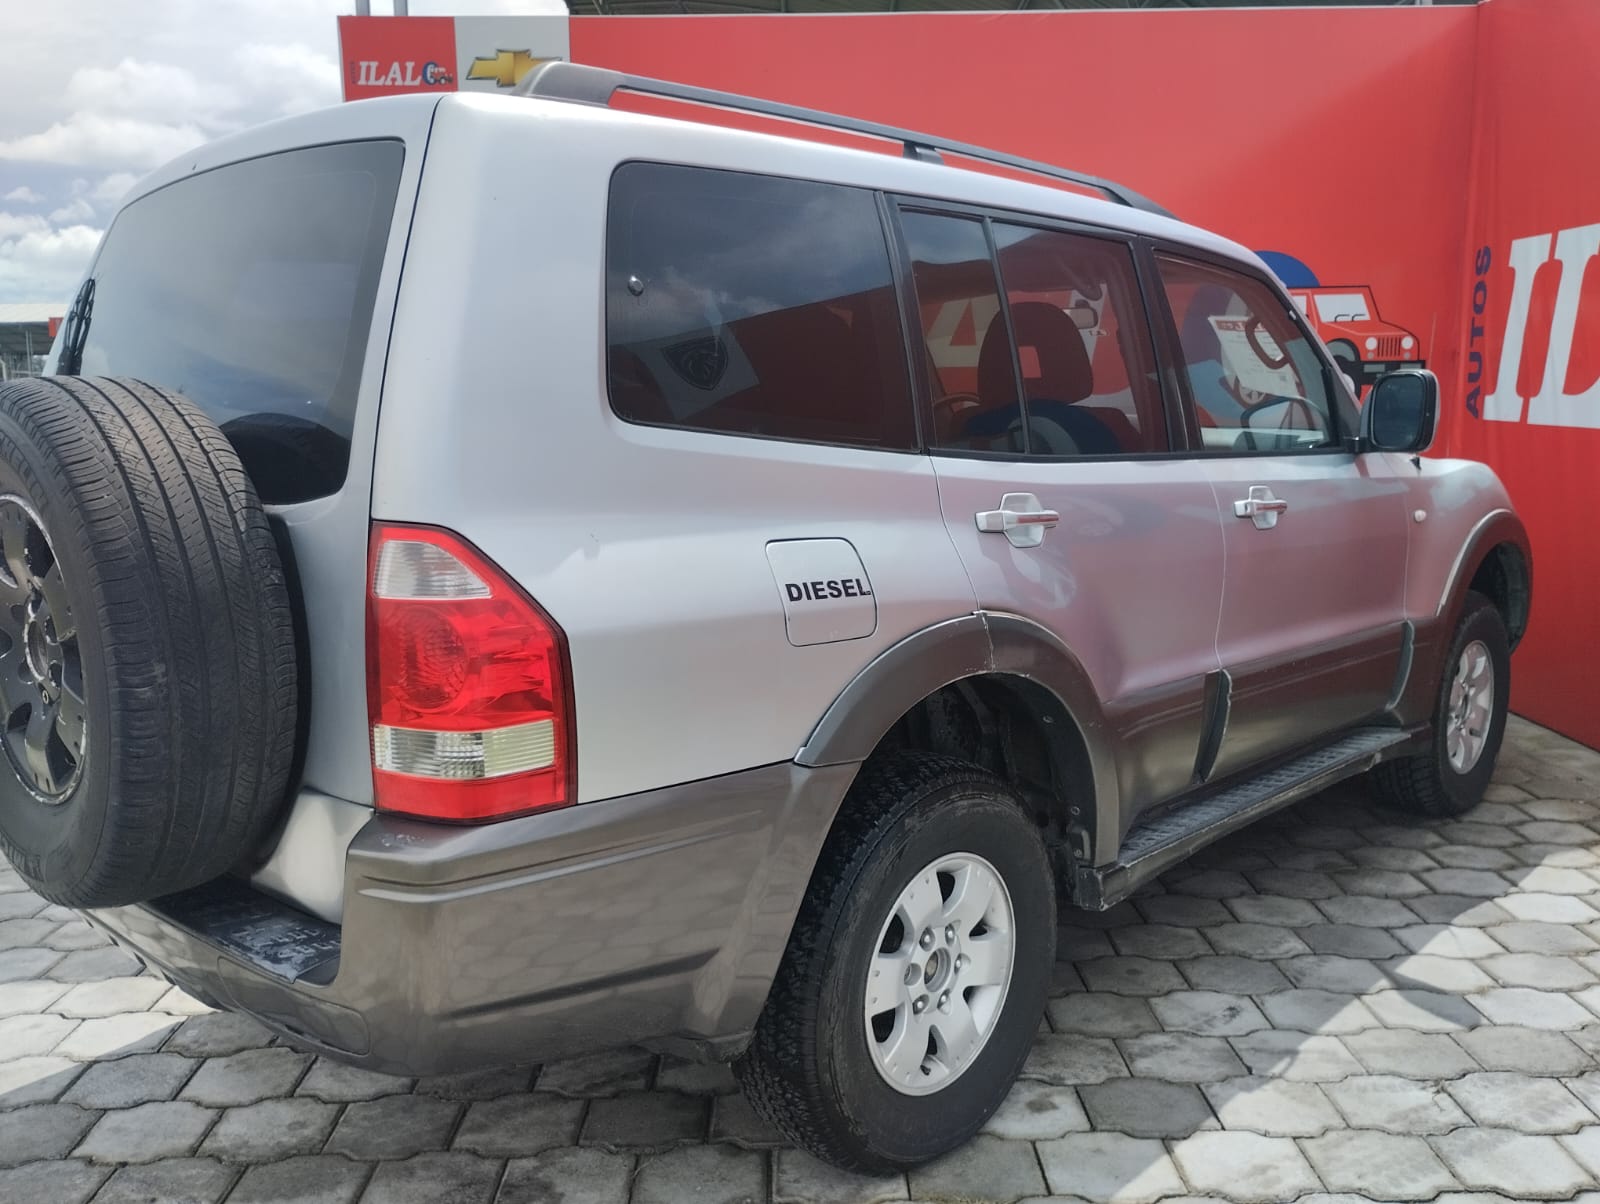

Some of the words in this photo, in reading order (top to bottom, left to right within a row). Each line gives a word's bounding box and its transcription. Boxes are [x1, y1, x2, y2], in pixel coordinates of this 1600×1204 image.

[357, 61, 422, 86] ILAL
[1466, 245, 1491, 419] AUTOS
[785, 578, 872, 602] DIESEL
